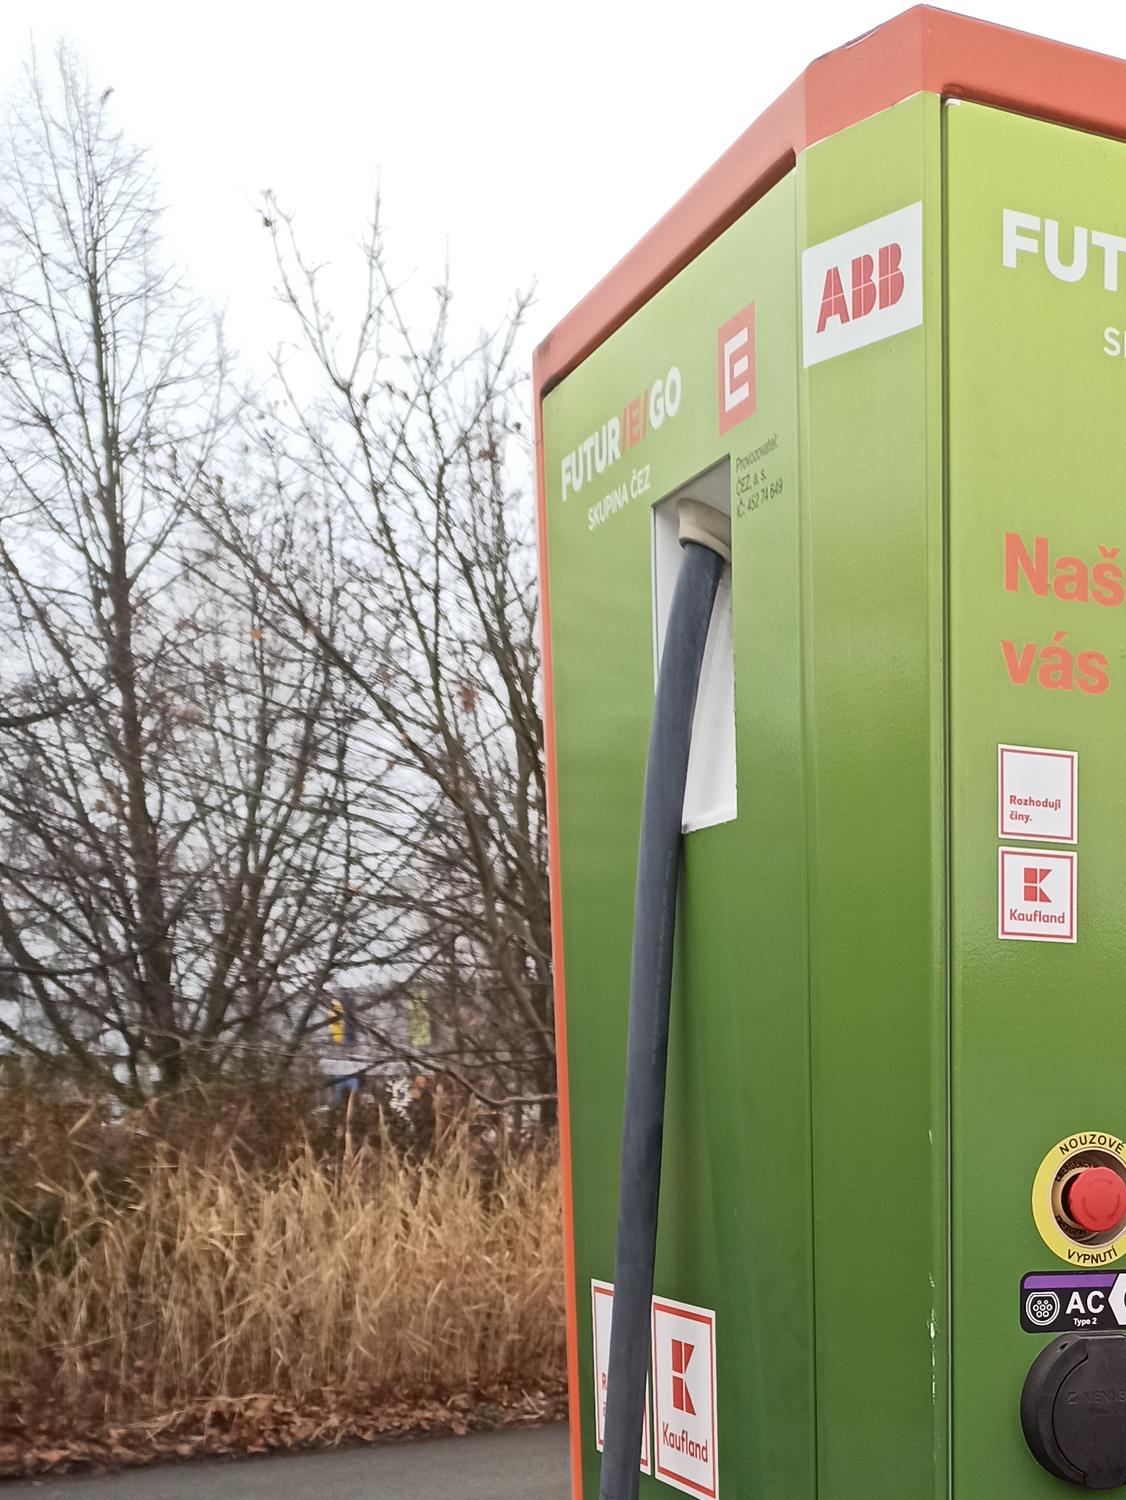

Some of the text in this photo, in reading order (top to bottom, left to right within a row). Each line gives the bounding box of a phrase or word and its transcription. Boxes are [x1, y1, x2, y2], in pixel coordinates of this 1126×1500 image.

[816, 242, 905, 333] ABB
[588, 464, 650, 531] SKUPINA ČEZ
[1001, 631, 1110, 695] vás
[1009, 795, 1062, 811] Rozhodují
[1009, 811, 1033, 824] činy.
[1009, 908, 1066, 924] Kaufland
[1059, 1134, 1125, 1155] NOUZOVÉ
[1067, 1245, 1118, 1264] VYPNUTÍ
[1066, 1290, 1105, 1314] AC
[1073, 1317, 1097, 1327] Type 2
[662, 1421, 709, 1464] Kaufland
